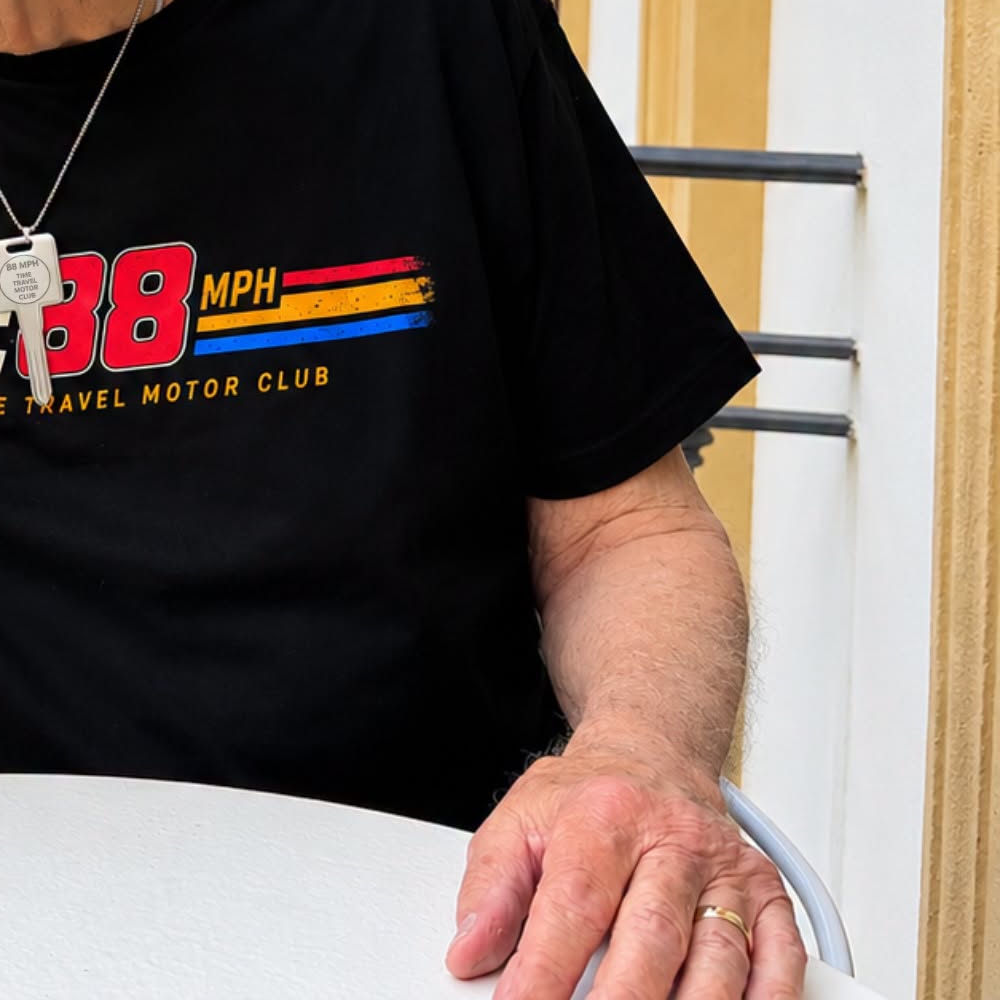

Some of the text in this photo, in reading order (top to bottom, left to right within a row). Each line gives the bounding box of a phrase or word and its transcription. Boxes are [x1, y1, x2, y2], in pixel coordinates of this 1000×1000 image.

[6, 260, 39, 271] 88 MPH
[12, 278, 38, 286] TRAVEL
[14, 285, 39, 293] MOTOR
[200, 266, 278, 311] MPH
[141, 375, 240, 405] MOTOR
[257, 366, 330, 393] CLUB
